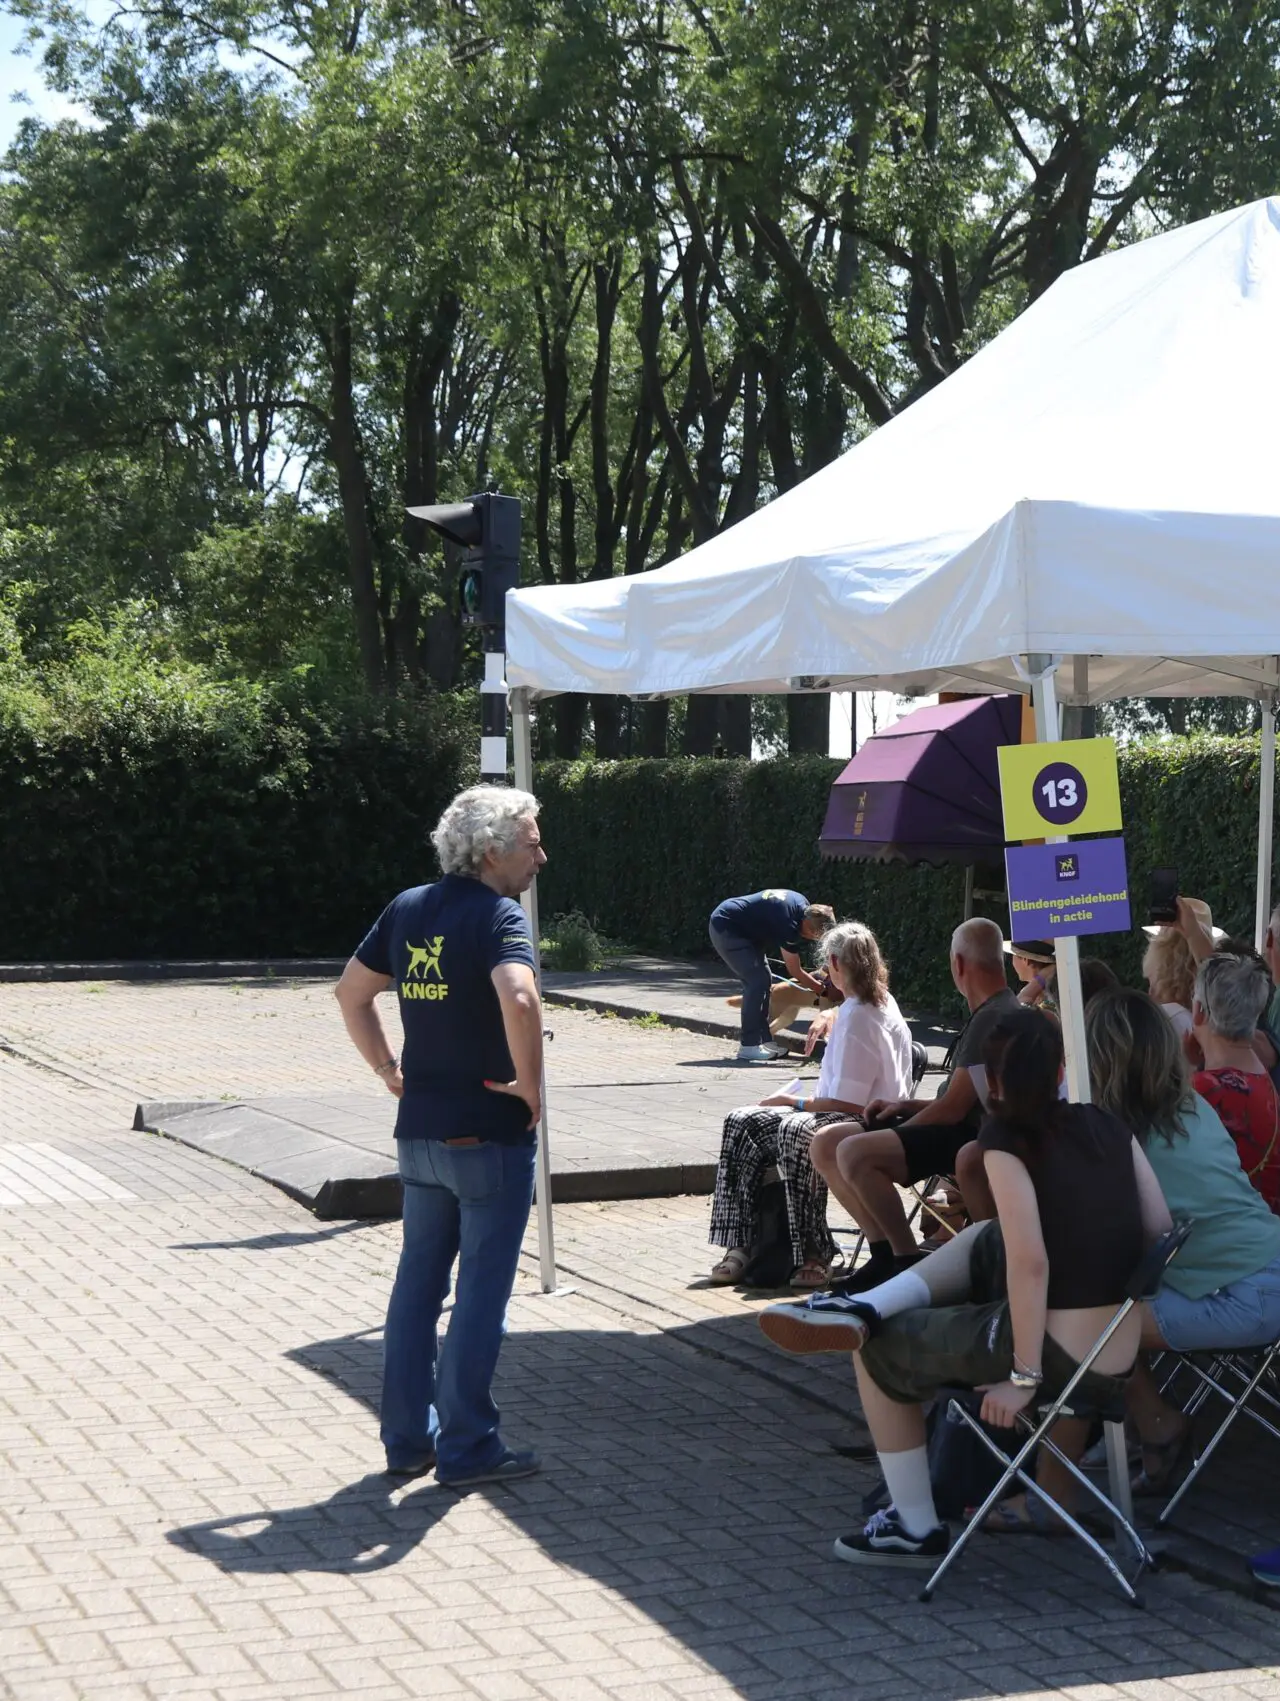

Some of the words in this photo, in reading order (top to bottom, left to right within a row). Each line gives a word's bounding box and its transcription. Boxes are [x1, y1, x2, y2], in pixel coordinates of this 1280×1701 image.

[1042, 778, 1078, 808] 13
[1059, 870, 1076, 878] KNGF
[1012, 890, 1128, 912] Blindengeleidehond
[1049, 913, 1061, 924] in
[1063, 910, 1093, 922] actie
[401, 982, 449, 1000] KNGF
